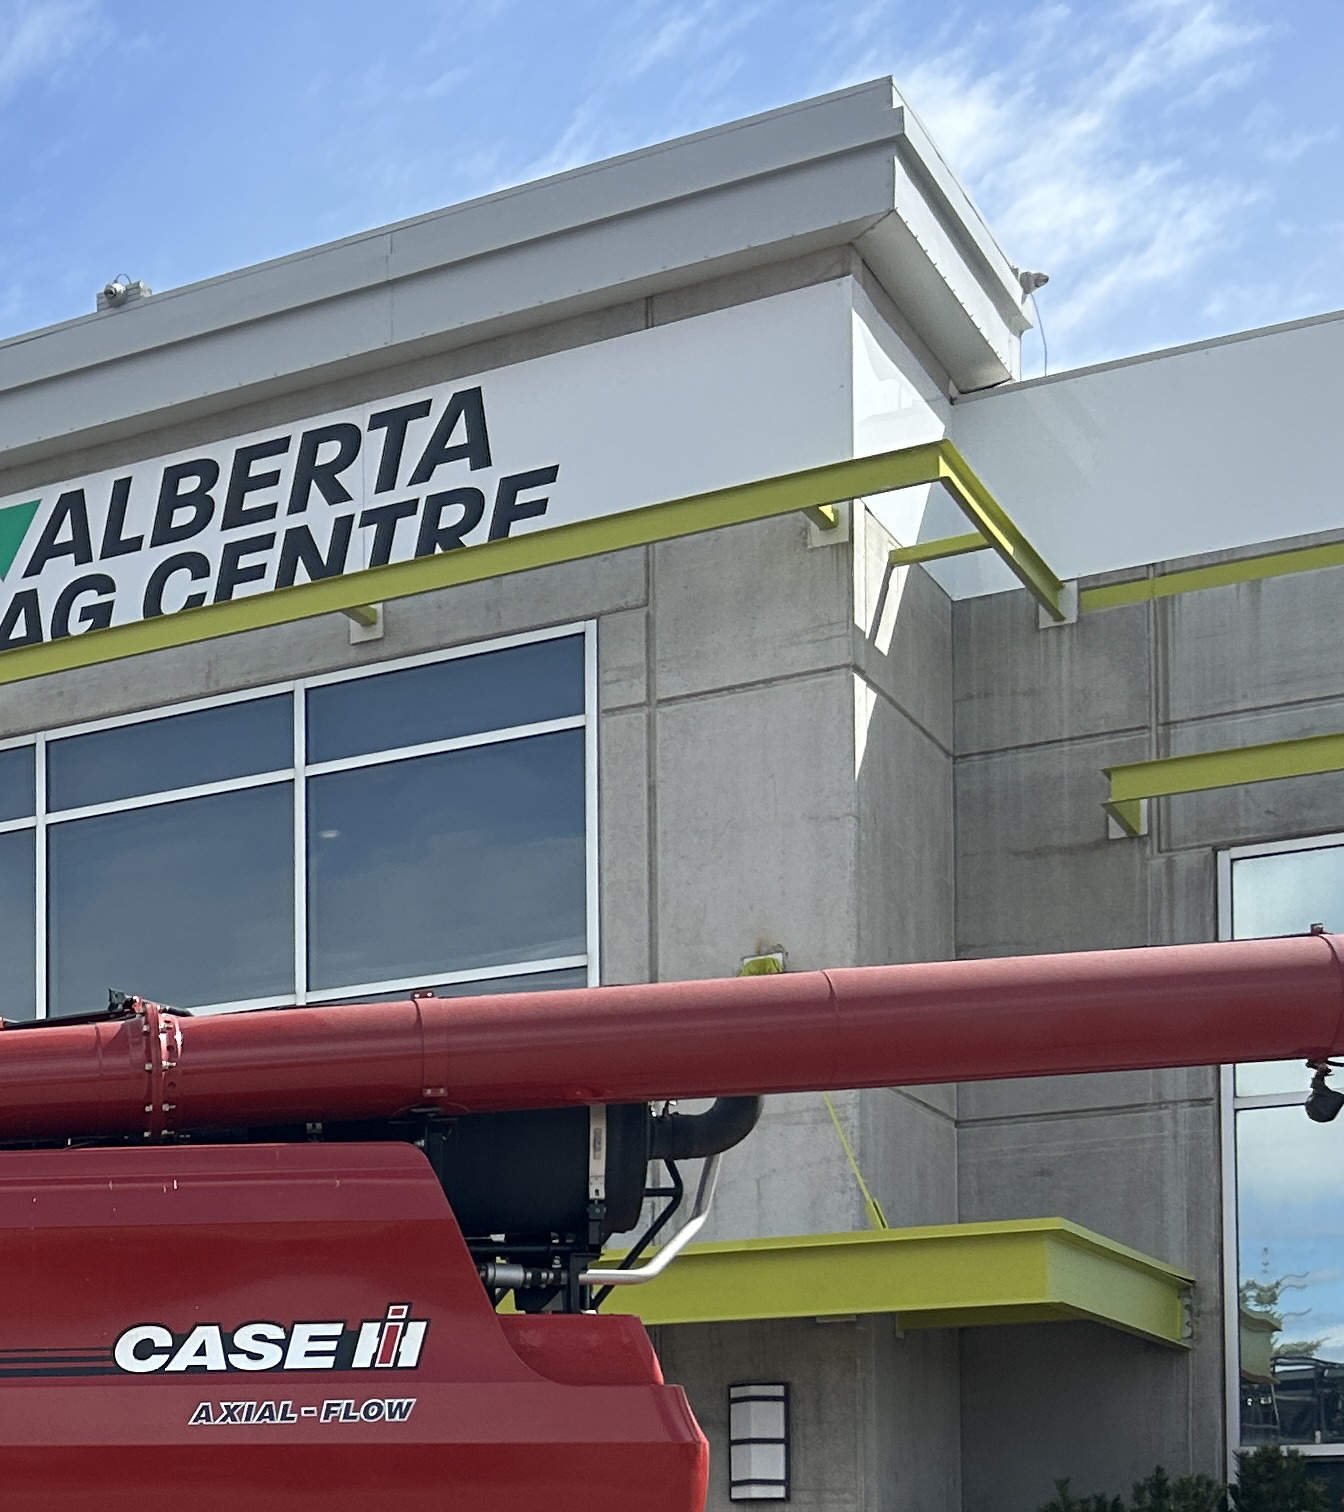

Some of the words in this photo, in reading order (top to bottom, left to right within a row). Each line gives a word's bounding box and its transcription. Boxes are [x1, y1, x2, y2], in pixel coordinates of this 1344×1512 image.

[23, 385, 495, 578] ALBERTA
[113, 1322, 345, 1373] CASE
[188, 1398, 417, 1425] AXIAL-FLOW
